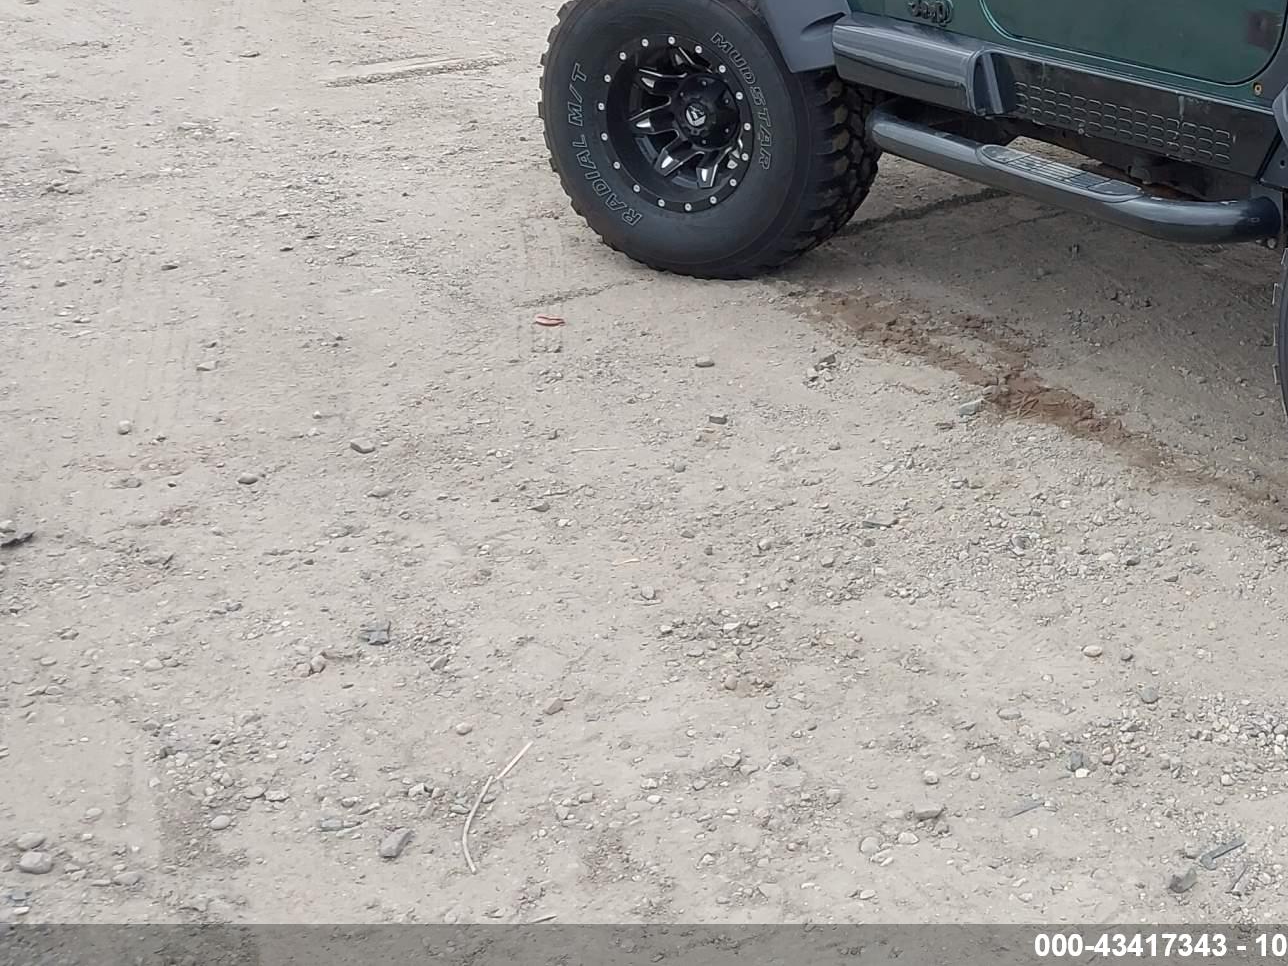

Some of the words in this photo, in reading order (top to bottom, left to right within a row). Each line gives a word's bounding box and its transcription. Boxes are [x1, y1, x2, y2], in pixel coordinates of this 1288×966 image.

[567, 62, 589, 127] M/T
[711, 32, 774, 171] MUDSTAR
[573, 134, 643, 227] RADIAL
